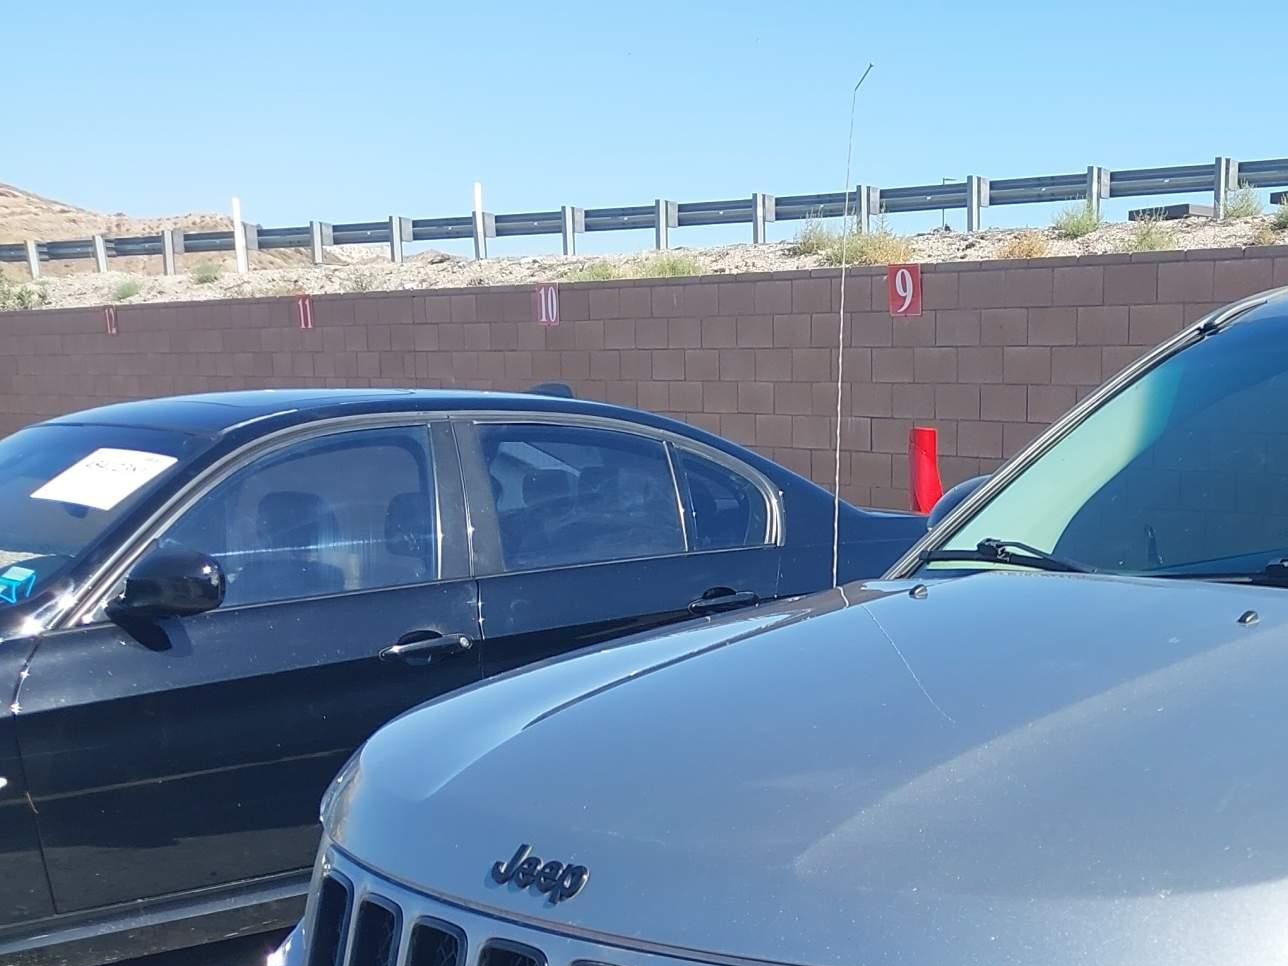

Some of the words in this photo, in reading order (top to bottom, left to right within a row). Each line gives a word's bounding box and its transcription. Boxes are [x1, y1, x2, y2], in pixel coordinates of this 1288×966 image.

[539, 286, 557, 322] 10
[895, 268, 913, 313] 9
[297, 298, 313, 329] 11
[491, 844, 589, 905] Jeep
